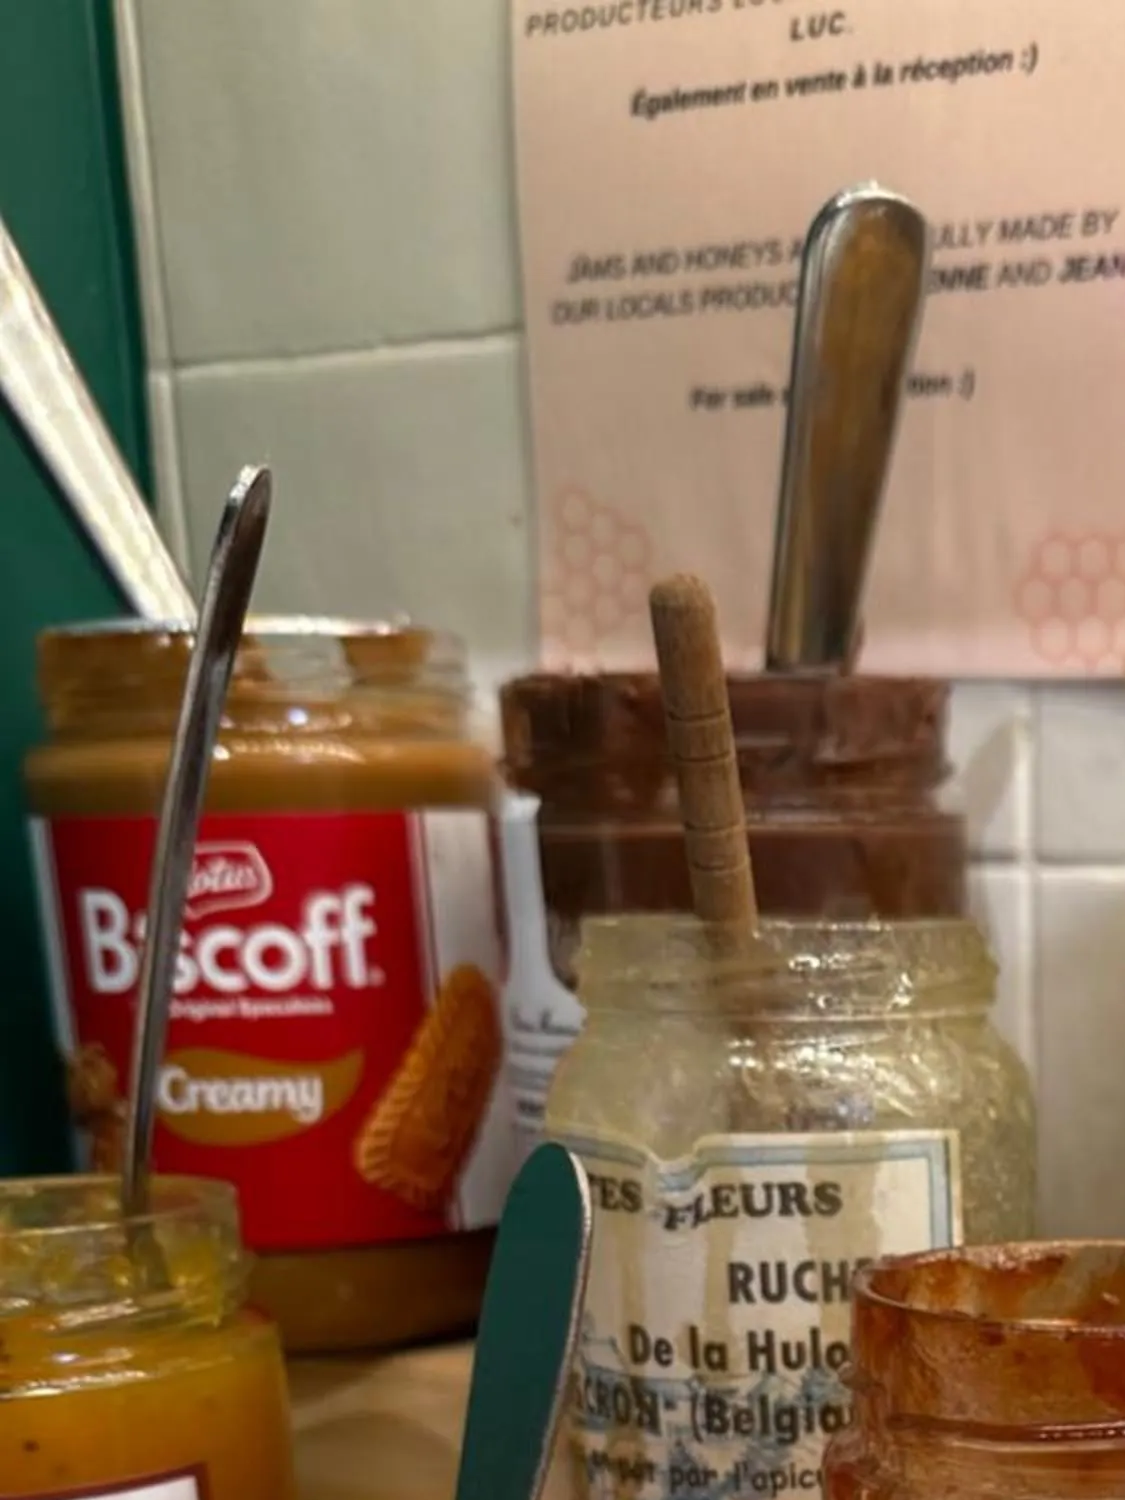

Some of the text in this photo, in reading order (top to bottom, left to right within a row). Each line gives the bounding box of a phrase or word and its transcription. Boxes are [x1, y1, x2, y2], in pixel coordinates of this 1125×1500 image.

[751, 79, 779, 101] en
[785, 70, 847, 97] vente
[851, 62, 867, 89] à
[872, 61, 893, 85] la
[900, 47, 1015, 84] réception
[630, 248, 680, 278] AND
[684, 239, 782, 272] HONEYS
[998, 212, 1076, 242] MADE
[1080, 206, 1121, 238] BY
[701, 279, 800, 312] PRODUC
[997, 258, 1053, 288] AND
[77, 882, 378, 994] Bscoff
[157, 1065, 324, 1124] Creamy
[628, 1324, 851, 1374] De la Hulo
